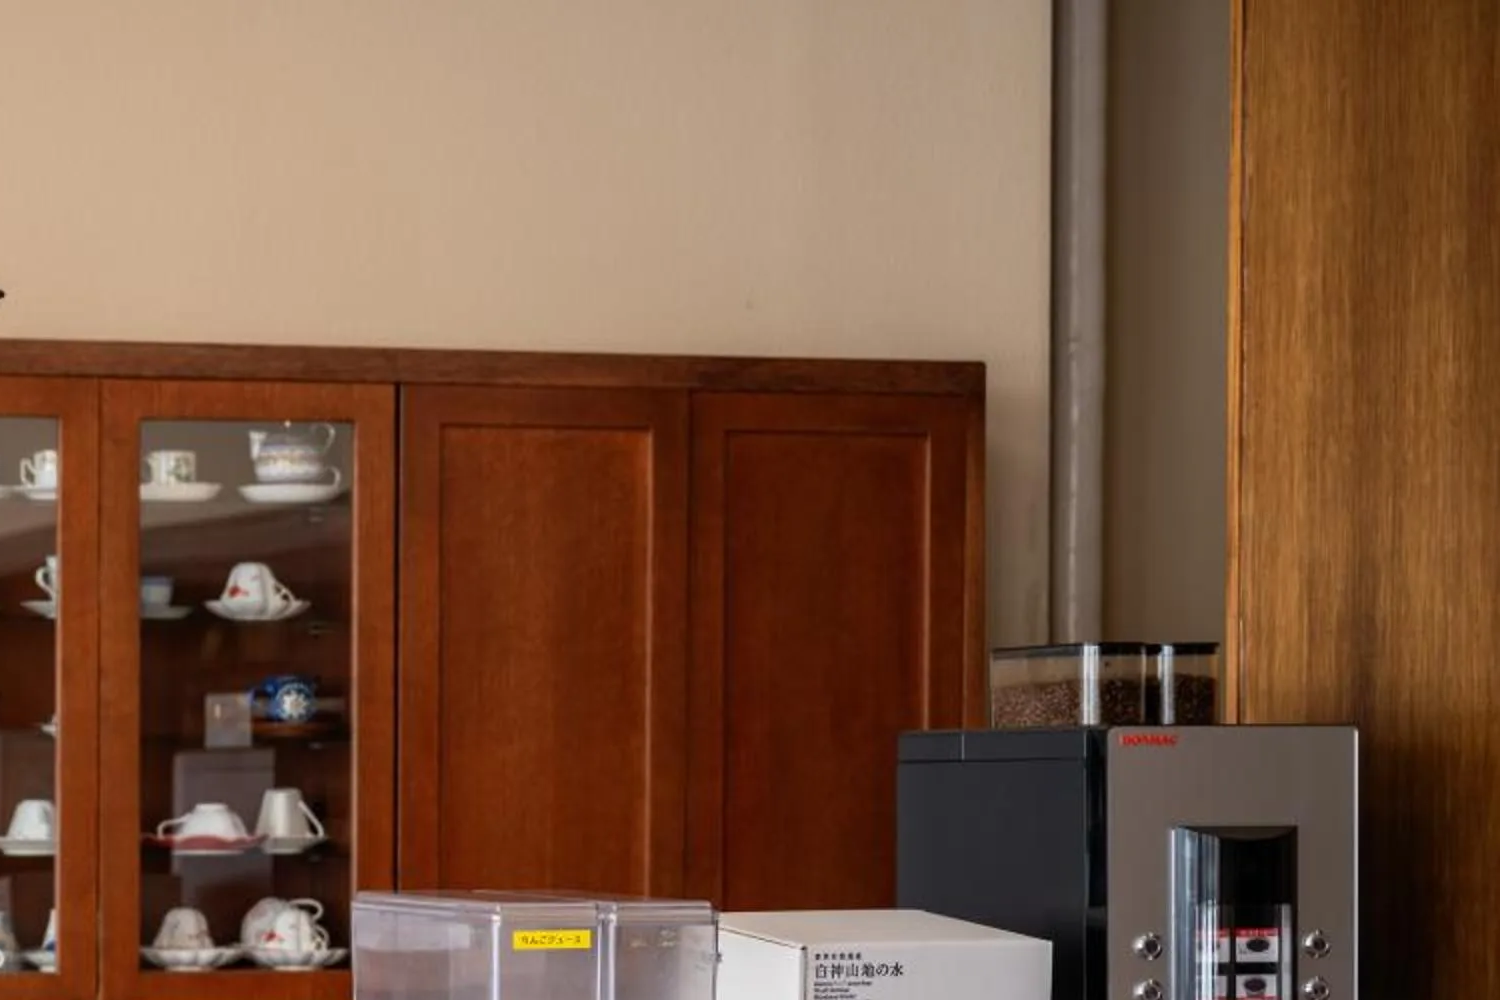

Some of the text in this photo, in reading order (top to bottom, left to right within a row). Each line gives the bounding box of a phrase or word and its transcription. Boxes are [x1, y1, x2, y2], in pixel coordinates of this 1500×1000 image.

[815, 962, 904, 979] 白神山地の水
